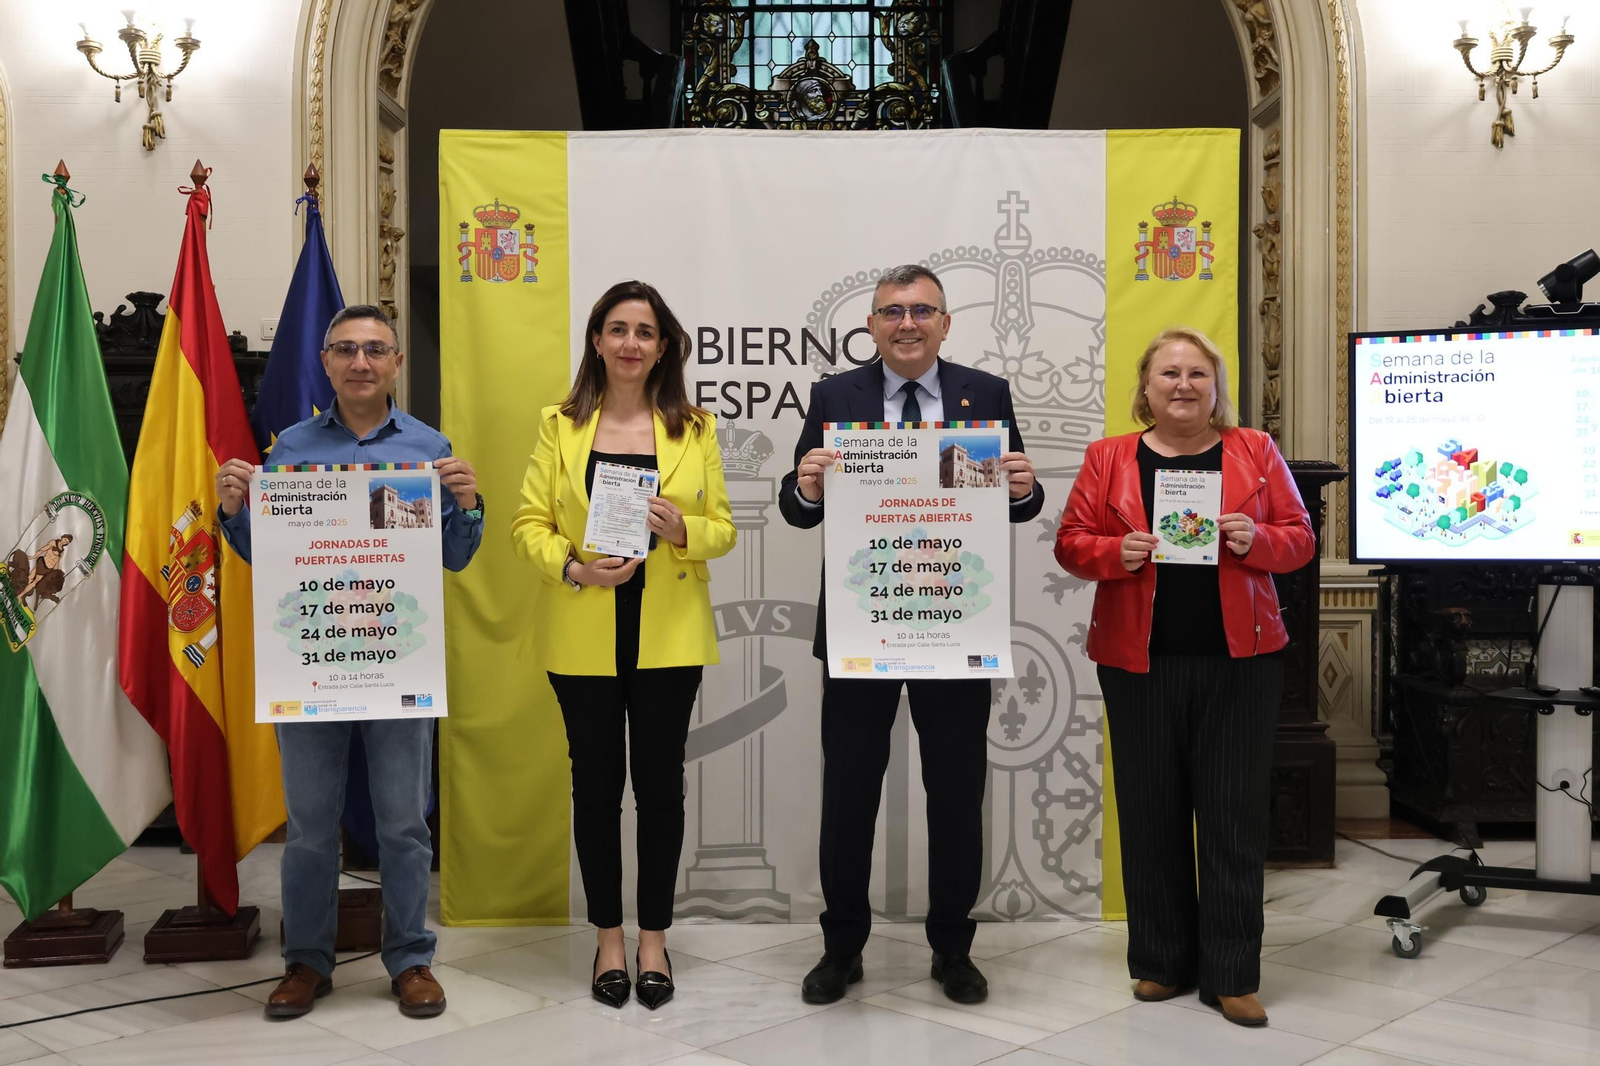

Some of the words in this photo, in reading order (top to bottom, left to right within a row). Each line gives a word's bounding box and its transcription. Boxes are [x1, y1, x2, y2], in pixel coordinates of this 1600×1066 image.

[697, 327, 881, 366] BIERNO
[1370, 352, 1444, 368] Semana
[1451, 350, 1474, 366] de
[1480, 349, 1495, 364] la
[1370, 368, 1495, 386] Administración
[695, 380, 808, 420] ESPA
[1371, 387, 1444, 405] Abierta
[834, 436, 884, 448] Semana
[888, 436, 904, 447] de
[907, 436, 917, 446] la
[834, 450, 918, 460] Administración
[834, 462, 884, 473] Abierta
[260, 479, 312, 490] Semana
[316, 478, 332, 489] de
[336, 478, 346, 488] la
[599, 473, 637, 484] Administración
[860, 479, 882, 487] mayo
[896, 477, 918, 485] 2025
[1160, 482, 1206, 490] Administración
[260, 491, 347, 503] Administración
[879, 498, 939, 508] JORNADAS
[941, 498, 956, 507] DE
[261, 504, 313, 516] Abierta
[288, 520, 312, 528] mayo
[313, 519, 324, 527] de
[326, 518, 348, 527] 2025
[865, 514, 916, 523] PUERTAS
[918, 513, 972, 523] ABIERTAS
[308, 539, 370, 550] JORNADAS
[373, 538, 388, 548] DE
[869, 538, 888, 550] 10
[892, 536, 914, 549] de
[918, 538, 962, 552] mayo
[295, 555, 348, 566] PUERTAS
[350, 553, 405, 564] ABIERTAS
[869, 562, 888, 576] 17
[891, 560, 913, 573] de
[917, 562, 962, 576] mayo
[299, 580, 319, 592] 10
[323, 578, 345, 591] de
[349, 579, 396, 593] mayo
[870, 586, 889, 599] 24
[893, 583, 914, 597] de
[918, 585, 963, 599] mayo
[300, 604, 319, 618] 17
[323, 601, 345, 615] de
[349, 602, 396, 617] mayo
[870, 610, 888, 623] 31
[892, 607, 914, 620] de
[918, 609, 962, 623] mayo
[301, 628, 320, 641] 24
[325, 625, 347, 638] de
[351, 626, 398, 640] mayo
[896, 632, 907, 640] 10
[916, 632, 925, 640] 14
[926, 631, 951, 639] horas
[301, 652, 320, 666] 31
[324, 649, 346, 662] de
[350, 649, 397, 664] mayo
[888, 664, 935, 672] transparencia
[329, 674, 339, 682] 10
[349, 673, 358, 681] 14
[360, 672, 385, 680] horas
[318, 704, 367, 714] transparencia
